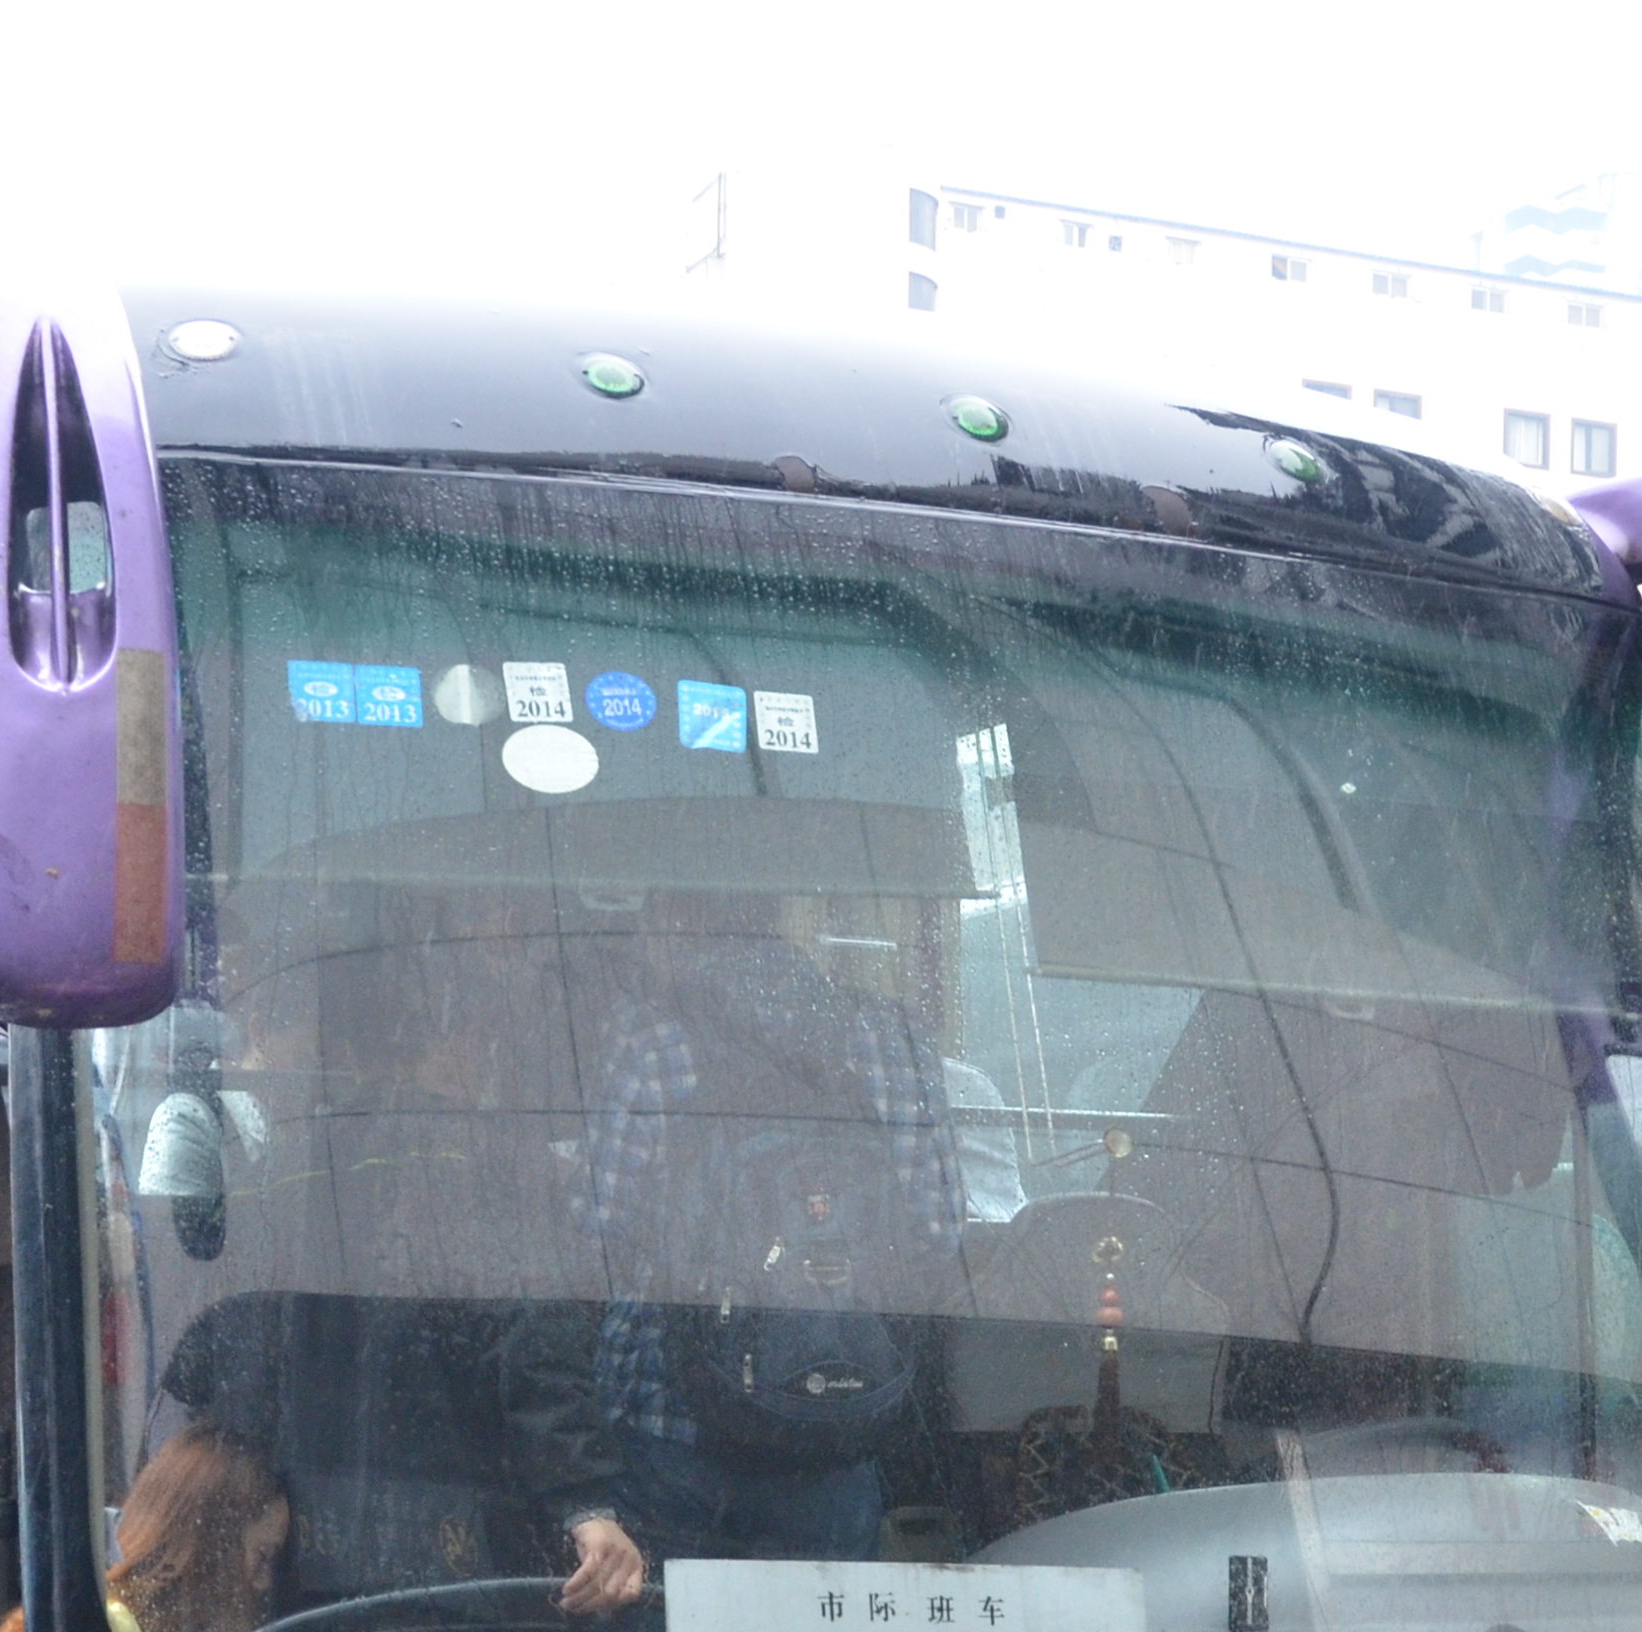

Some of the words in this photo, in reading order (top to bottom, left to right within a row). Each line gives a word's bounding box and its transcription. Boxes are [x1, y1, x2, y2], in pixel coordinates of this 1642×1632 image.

[365, 703, 418, 723] 2013
[517, 699, 566, 719] 2014
[602, 698, 642, 717] 2014
[764, 729, 812, 749] 2014
[817, 1591, 1005, 1627] 市际班车
